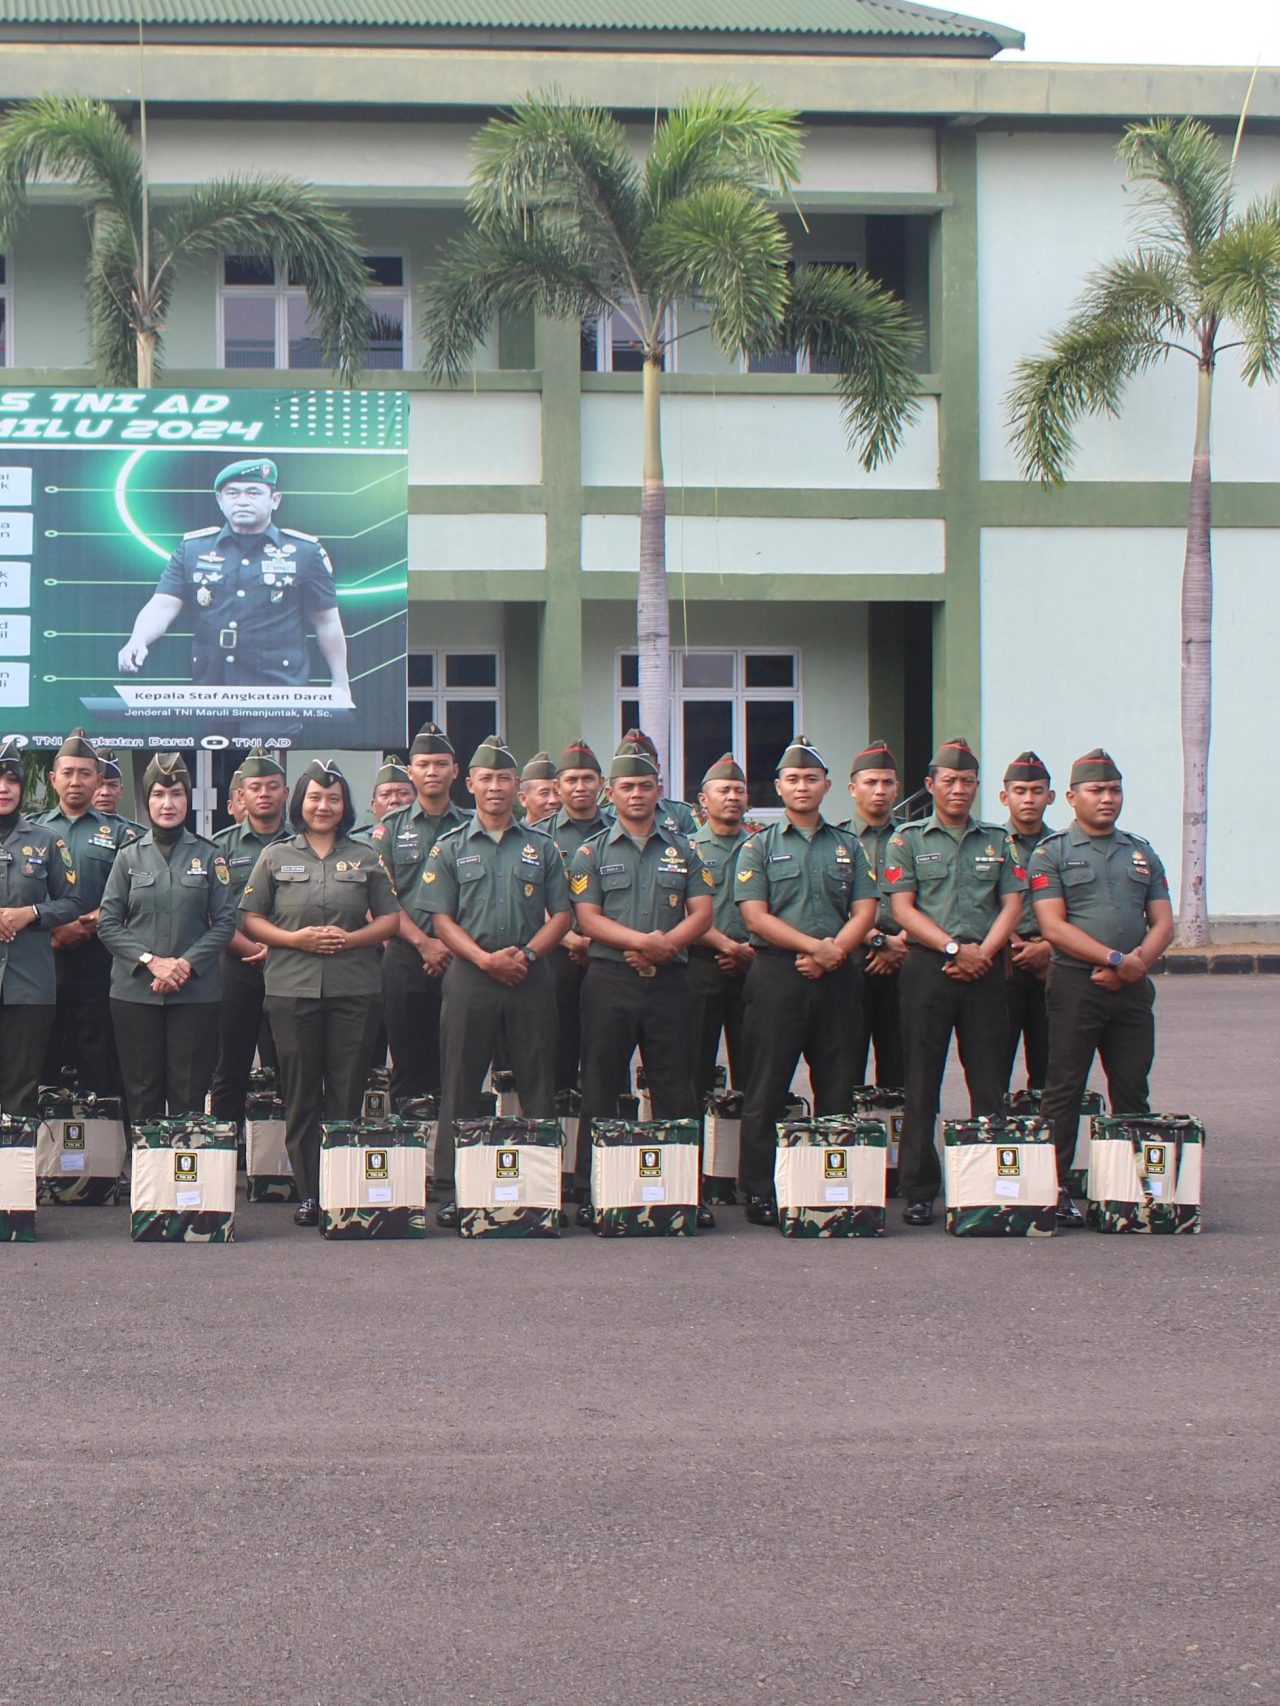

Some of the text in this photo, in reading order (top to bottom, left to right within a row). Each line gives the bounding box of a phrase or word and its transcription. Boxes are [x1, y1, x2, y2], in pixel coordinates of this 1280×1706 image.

[49, 392, 147, 413] TNI
[152, 393, 230, 414] AD
[120, 419, 264, 441] 2024
[134, 691, 334, 702] Kepala Staf Angkatan Darat
[124, 708, 333, 718] Jenderal TNI Maruli Simanjuntak, M.Sc.
[32, 735, 195, 748] TNI gkatan Darat
[231, 737, 292, 748] TNI AD
